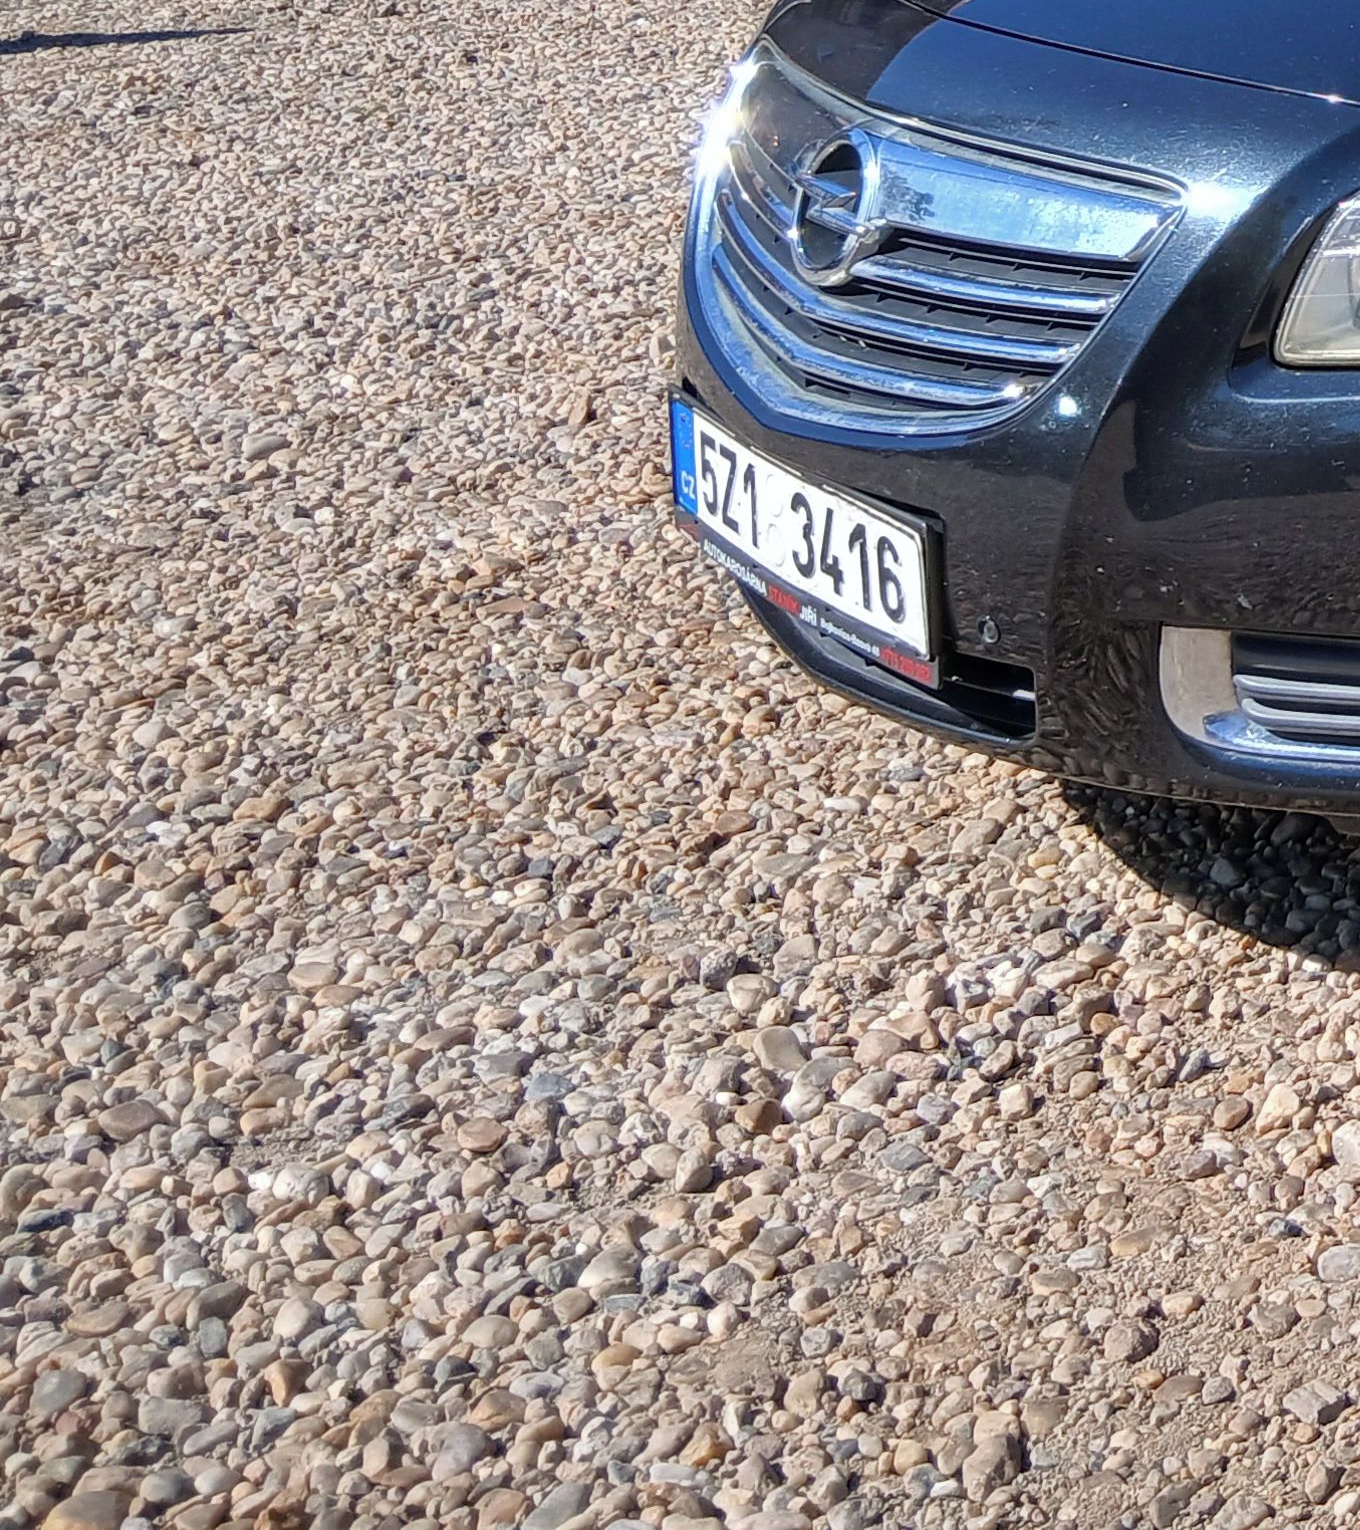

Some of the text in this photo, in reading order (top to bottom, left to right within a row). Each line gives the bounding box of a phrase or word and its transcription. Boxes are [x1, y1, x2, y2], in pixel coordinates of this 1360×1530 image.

[680, 469, 696, 499] CZ
[700, 430, 906, 624] 5Z1 3416
